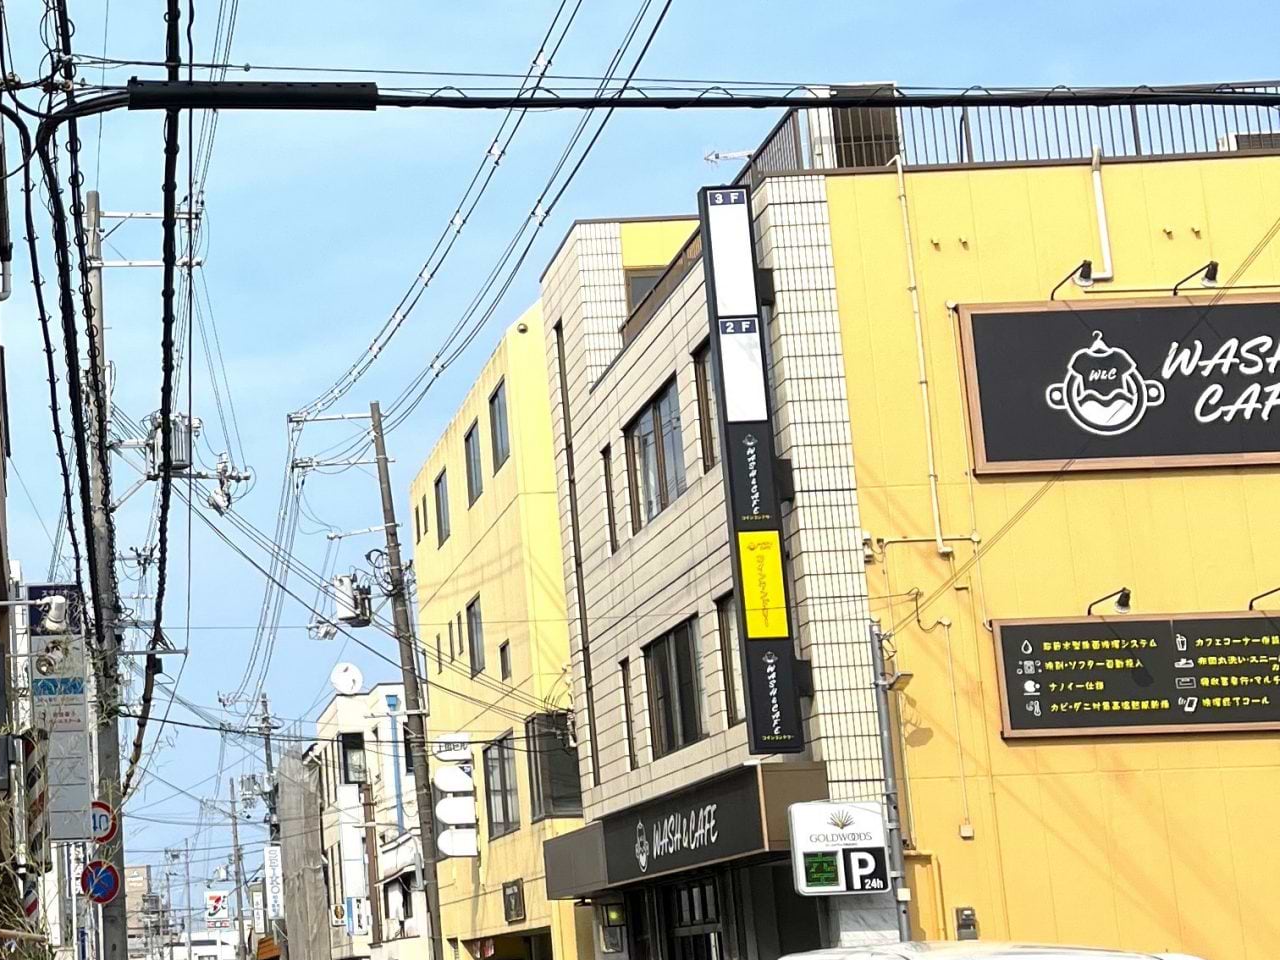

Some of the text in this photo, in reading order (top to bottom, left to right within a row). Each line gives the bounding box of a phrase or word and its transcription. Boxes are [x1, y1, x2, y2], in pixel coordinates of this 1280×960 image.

[809, 832, 872, 843] GOLDWOODS
[850, 852, 876, 890] P
[864, 878, 884, 889] 24h
